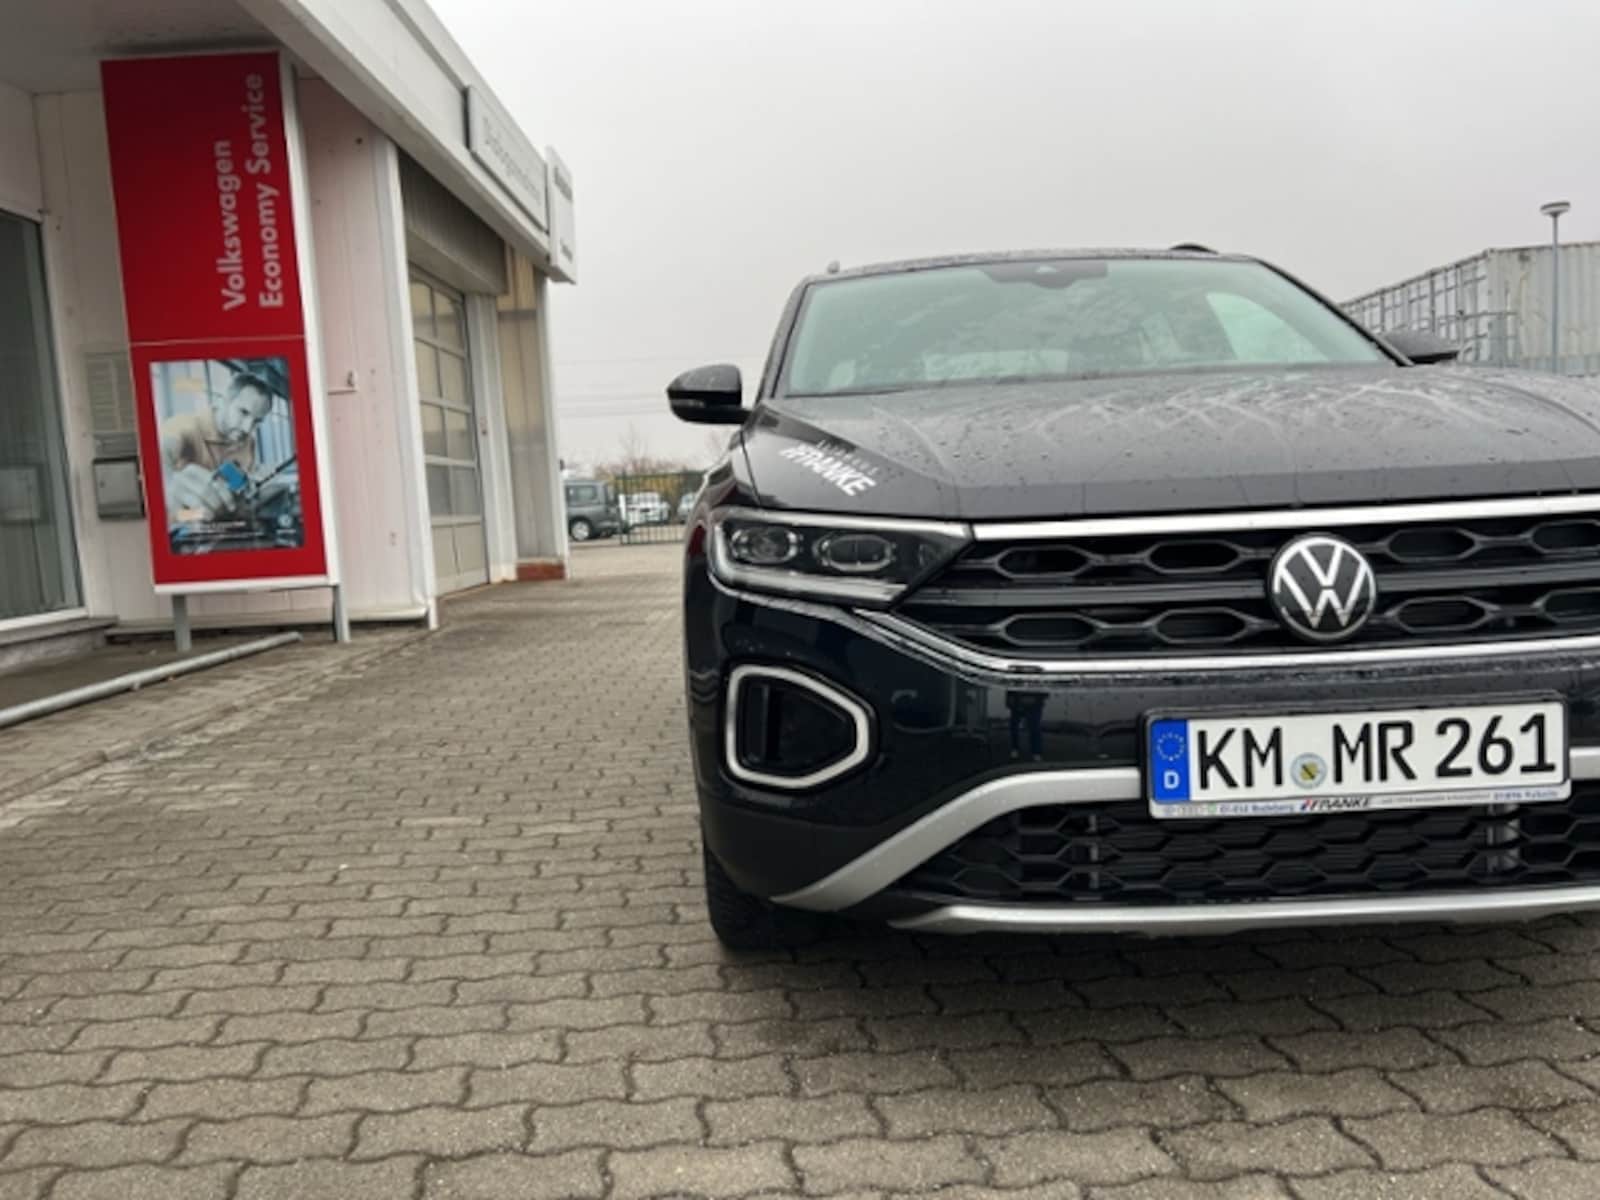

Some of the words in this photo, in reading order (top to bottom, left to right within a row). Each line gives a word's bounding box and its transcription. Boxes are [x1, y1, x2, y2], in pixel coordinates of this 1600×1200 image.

[241, 73, 271, 175] Service
[214, 139, 247, 311] Volkswagen
[255, 182, 284, 309] Economy
[1163, 771, 1180, 790] D
[1197, 726, 1284, 790] KM
[1332, 720, 1417, 783] MR
[1434, 713, 1556, 778] 261
